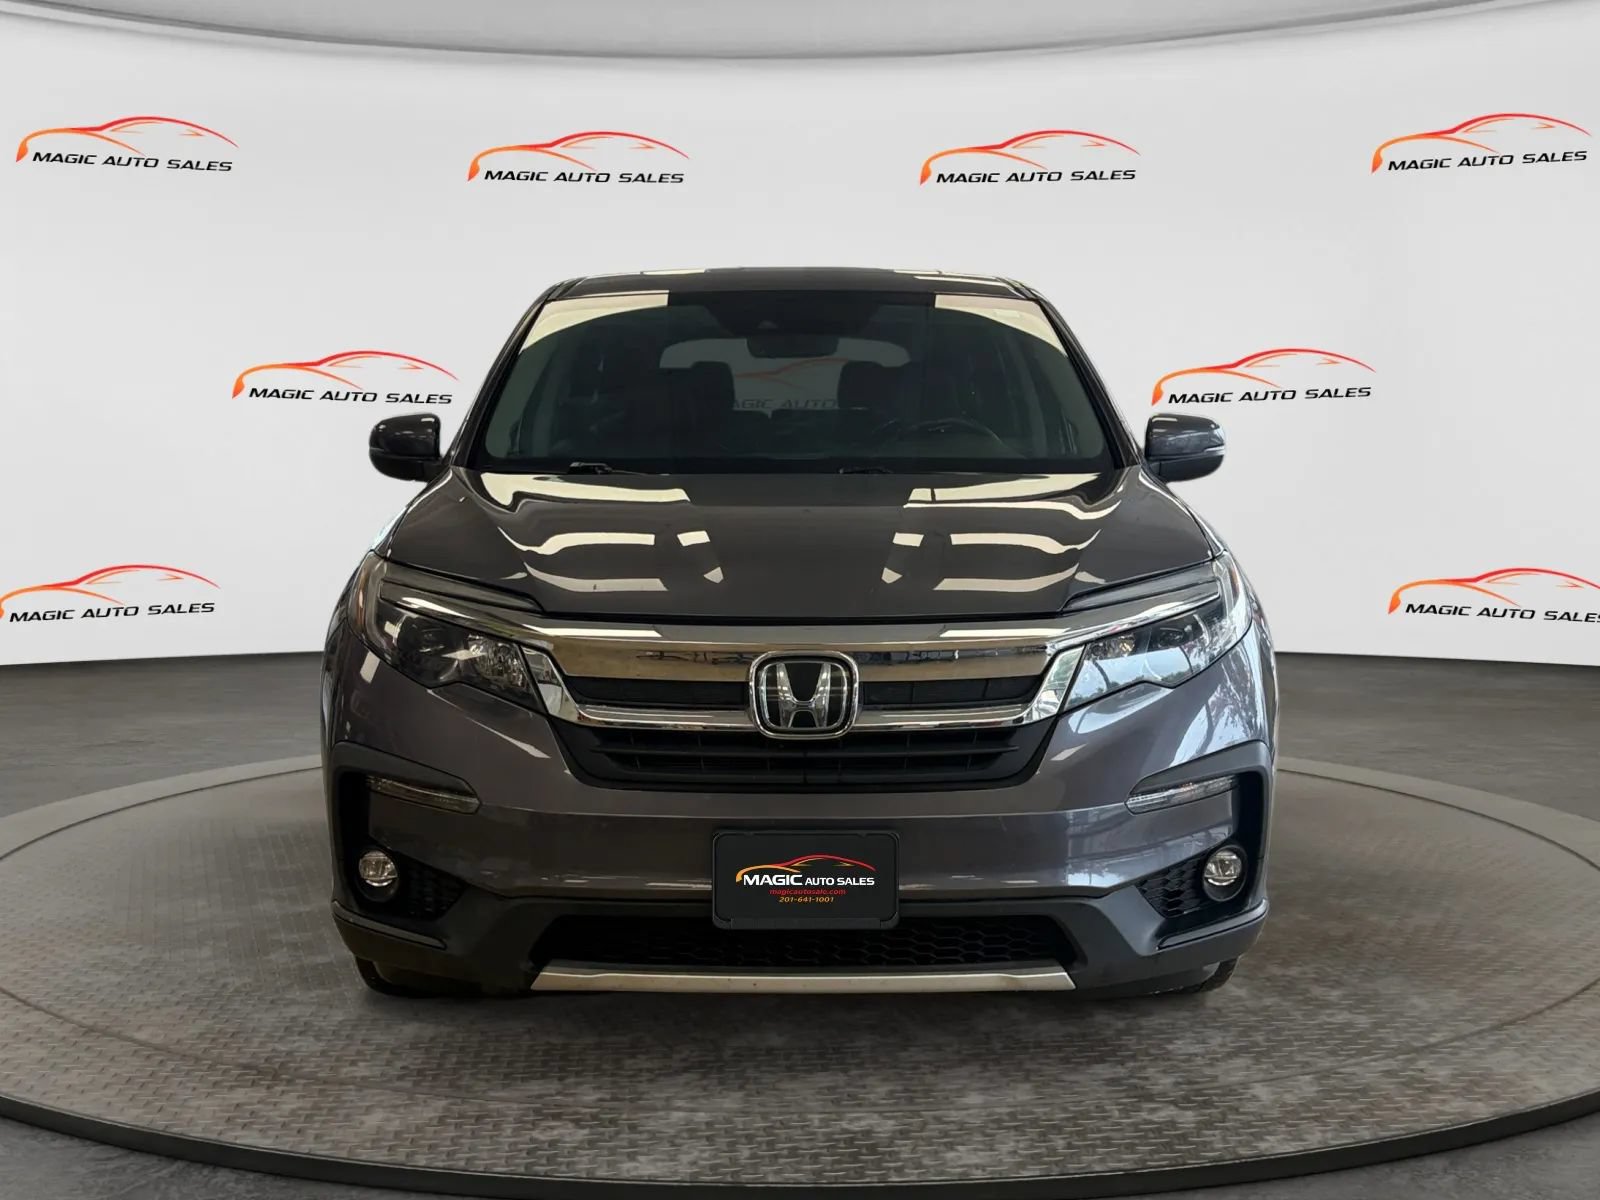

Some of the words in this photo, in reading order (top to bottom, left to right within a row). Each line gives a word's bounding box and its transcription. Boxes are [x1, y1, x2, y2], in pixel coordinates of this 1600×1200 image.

[32, 151, 98, 165] MAGIC
[102, 155, 160, 168] AUTO
[166, 159, 233, 172] SALES
[1387, 157, 1452, 171] MAGIC
[1457, 154, 1515, 168] AUTO
[1522, 150, 1588, 164] SALES
[484, 170, 549, 182] MAGIC
[553, 171, 611, 183] AUTO
[618, 172, 685, 184] SALES
[936, 172, 1001, 184] MAGIC
[1005, 171, 1063, 183] AUTO
[1070, 169, 1136, 181] SALES
[248, 387, 315, 400] MAGIC
[319, 390, 378, 403] AUTO
[385, 392, 453, 405] SALES
[1168, 392, 1234, 404] MAGIC
[1238, 389, 1297, 402] AUTO
[1305, 386, 1372, 400] SALES
[780, 399, 839, 410] AUTO
[9, 609, 76, 623] MAGIC
[80, 606, 140, 619] AUTO
[147, 602, 215, 616] SALES
[1405, 603, 1472, 616] MAGIC
[1476, 607, 1536, 620] AUTO
[1543, 610, 1600, 623] SALE
[743, 874, 803, 886] MAGIC
[804, 877, 835, 886] AUTO
[837, 877, 875, 886] SALES
